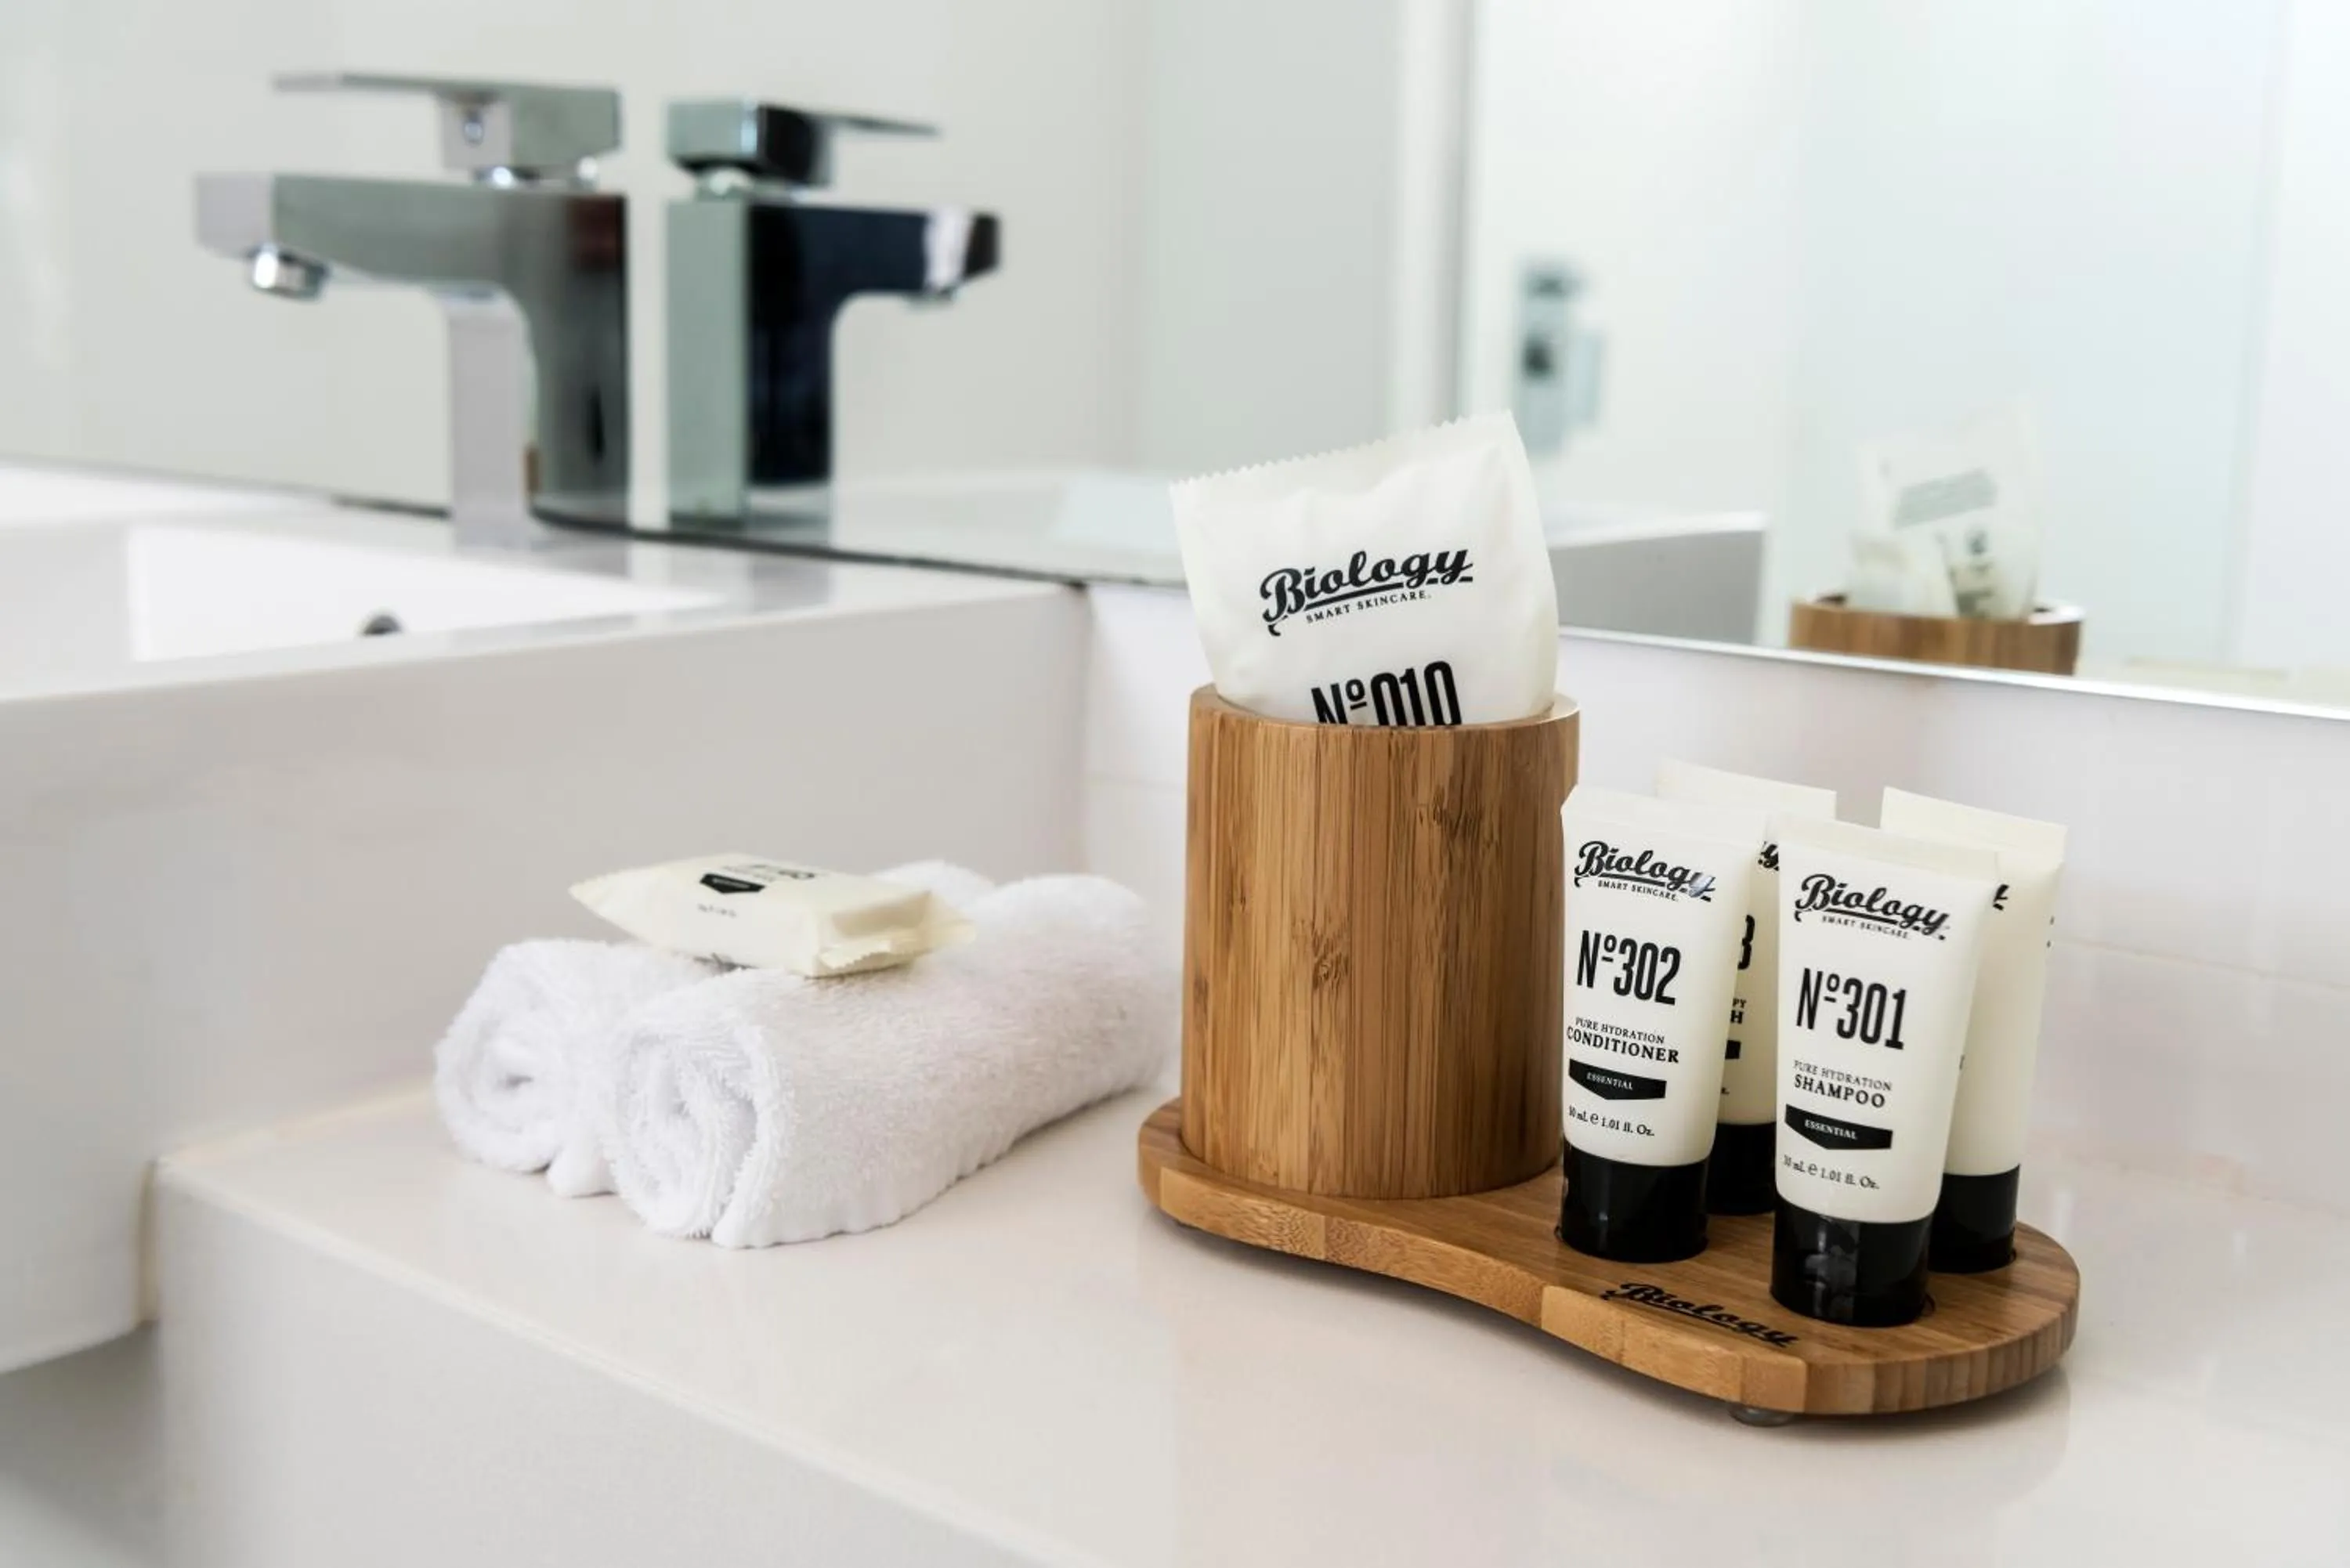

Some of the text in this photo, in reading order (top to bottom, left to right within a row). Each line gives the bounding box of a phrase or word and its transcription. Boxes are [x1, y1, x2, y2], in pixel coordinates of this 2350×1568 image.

[1259, 548, 1473, 636] Biology
[1306, 605, 1351, 623] SMART
[1574, 840, 1716, 902] Biology
[1598, 880, 1628, 891] SMART
[1794, 873, 1950, 940] Biology
[1822, 915, 1856, 928] SMART
[1567, 1026, 1679, 1063] CONDITIONER
[1575, 1017, 1665, 1044] PURE HYDRATION
[1586, 1072, 1633, 1090] ESSENTIAL
[1793, 1060, 1893, 1091] PURE HYDRATION
[1794, 1074, 1885, 1108] SHAMPOO
[1804, 1119, 1857, 1139] ESSENTIAL
[1600, 1283, 1799, 1348] Biology
